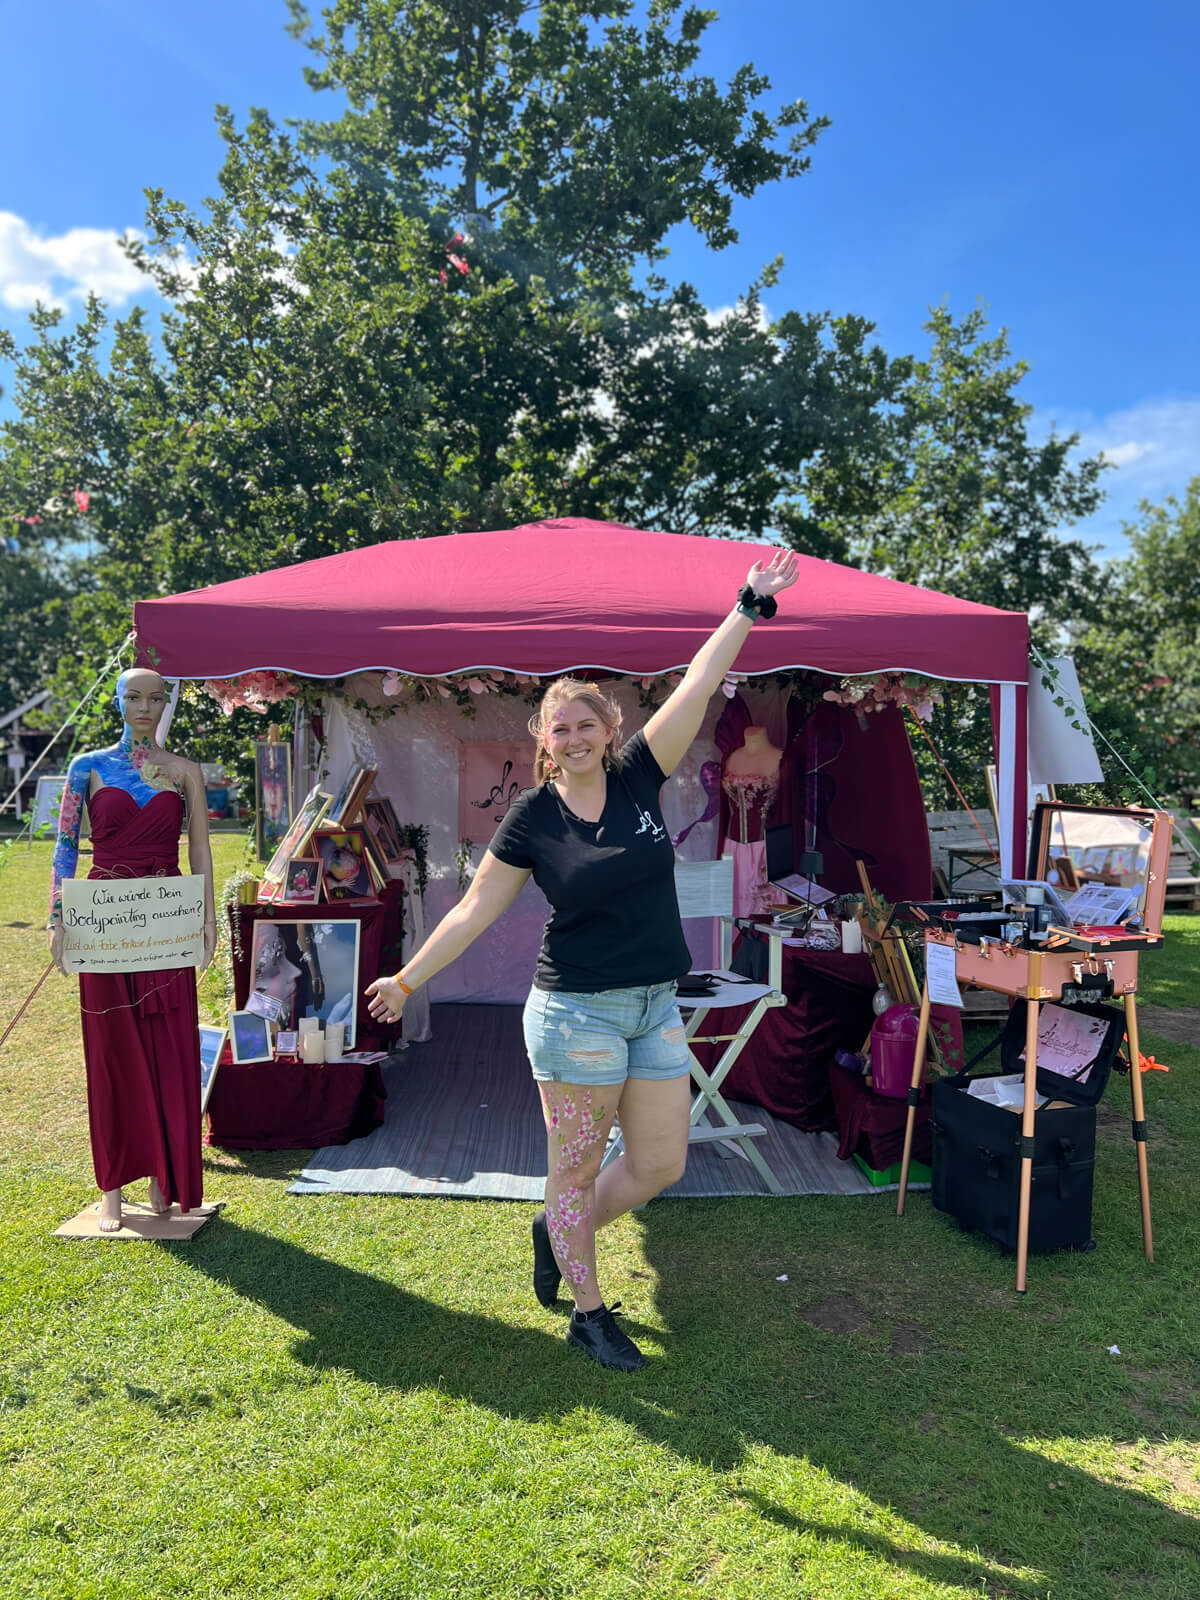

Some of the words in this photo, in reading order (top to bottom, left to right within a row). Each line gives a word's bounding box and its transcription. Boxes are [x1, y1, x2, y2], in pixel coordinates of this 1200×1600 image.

[92, 889, 116, 905] Wie
[118, 887, 152, 903] würde
[158, 886, 182, 900] Dein
[66, 907, 147, 934] Bodypainting
[152, 899, 203, 920] aussehen?
